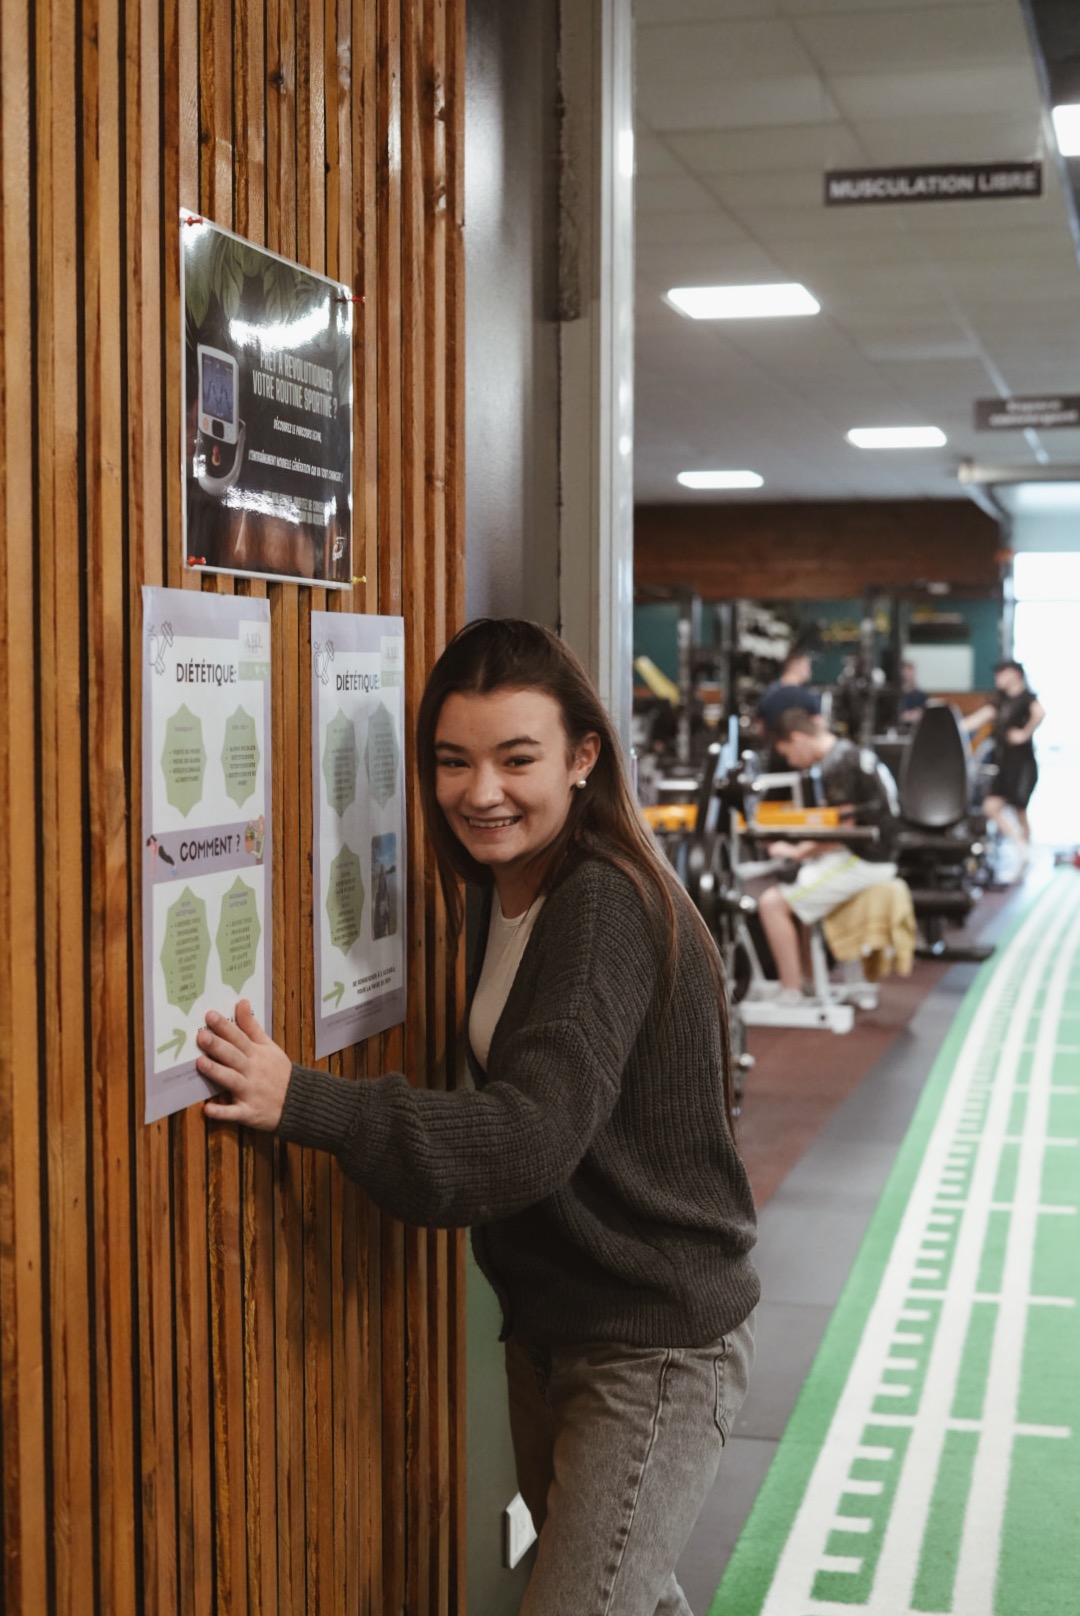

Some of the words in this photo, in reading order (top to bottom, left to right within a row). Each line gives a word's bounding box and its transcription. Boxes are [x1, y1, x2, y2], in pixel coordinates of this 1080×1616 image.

[829, 174, 975, 199] MUSCULATION
[977, 170, 1037, 193] LIBRE
[252, 369, 275, 400] VOTRE
[275, 377, 303, 409] ROUTINE
[303, 387, 333, 419] SPORTIVE
[332, 397, 338, 420] ?
[180, 835, 232, 862] COMMENT
[236, 834, 241, 853] ?
